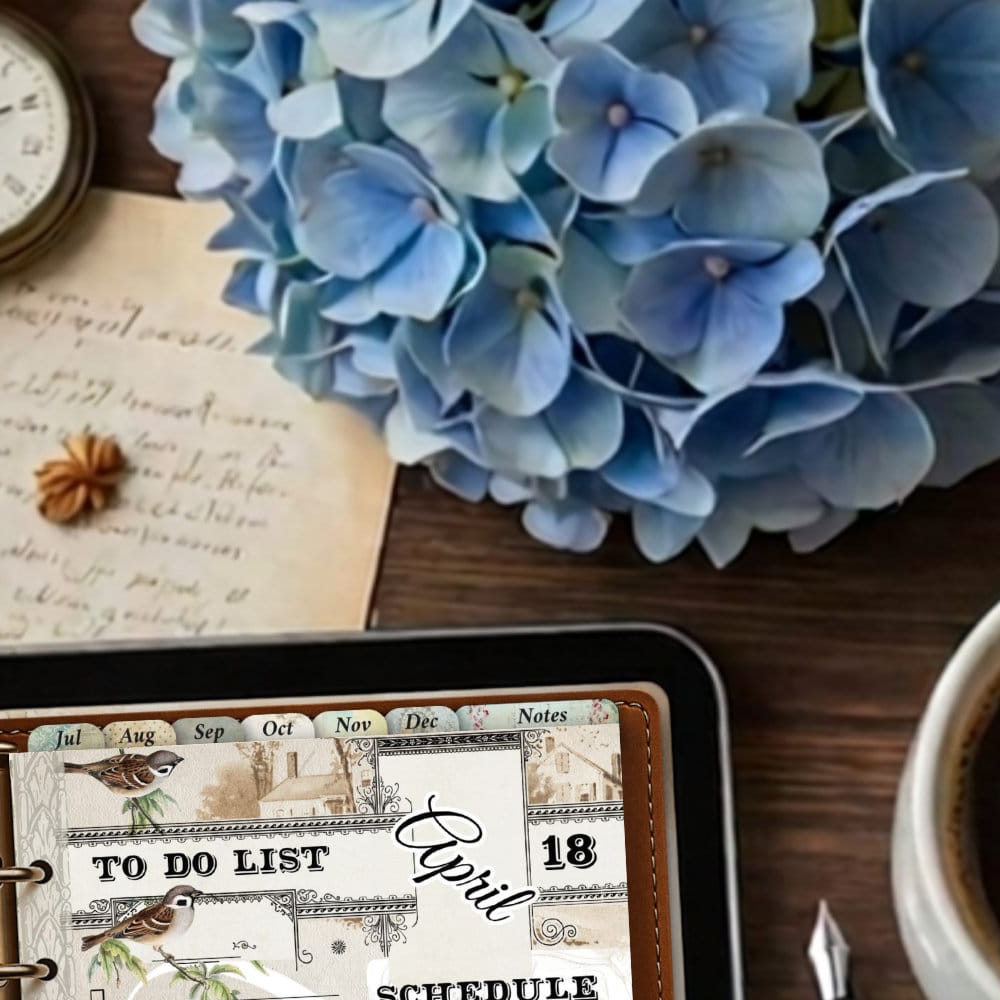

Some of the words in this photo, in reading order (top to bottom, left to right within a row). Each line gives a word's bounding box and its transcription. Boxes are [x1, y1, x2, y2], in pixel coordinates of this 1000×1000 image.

[335, 716, 372, 733] Nov
[405, 713, 439, 730] Dec
[518, 706, 568, 724] Notes
[55, 728, 82, 747] Jul
[118, 727, 156, 746] Aug
[194, 723, 225, 744] Sep
[262, 720, 293, 737] Oct
[395, 795, 535, 922] April
[541, 833, 598, 871] 18
[92, 855, 148, 883] TO
[163, 851, 218, 879] DO
[232, 845, 330, 876] LIST
